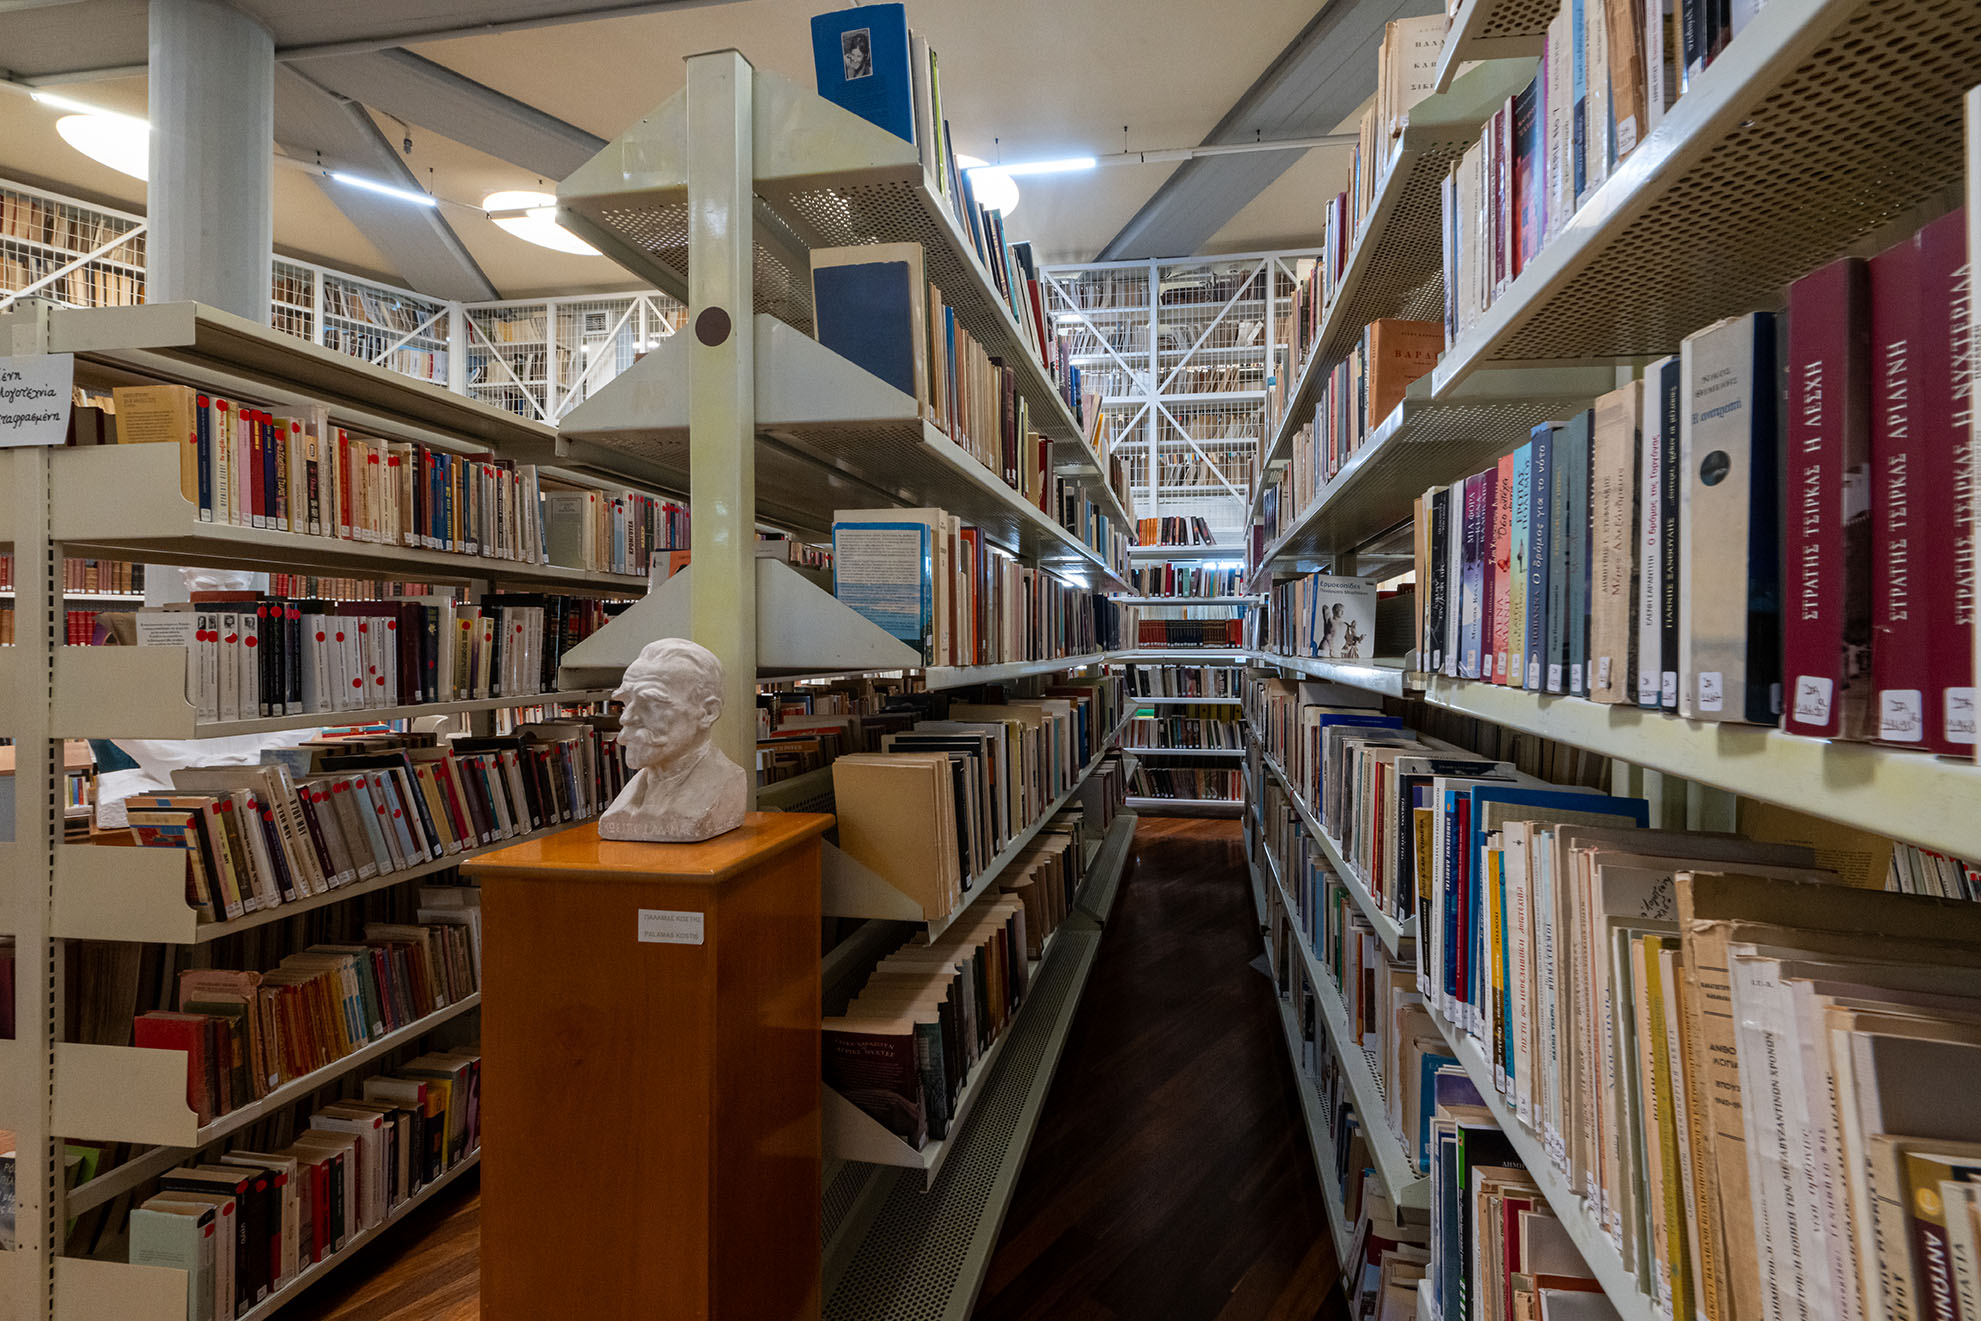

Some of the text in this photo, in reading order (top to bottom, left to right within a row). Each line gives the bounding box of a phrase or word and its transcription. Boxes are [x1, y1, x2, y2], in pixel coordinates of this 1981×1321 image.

[0, 368, 22, 382] ένη
[0, 409, 61, 429] ταφρασμένη
[1951, 412, 1972, 429] Η
[1536, 444, 1546, 473] νότο
[1648, 434, 1661, 479] Γοργόνας
[1537, 478, 1545, 493] το
[1650, 481, 1660, 497] της
[1802, 360, 1824, 621] ΣΤΡΑΤΗΣ ΤΣΙΡΚΑΣ Η ΛΕΣΧΗ
[1886, 339, 1909, 622] ΣΤΡΑΤΗΣ ΤΣΙΡΚΑΣ ΑΡΙΑΓΝΗ
[1953, 441, 1974, 531] ΤΣΙΡΚΑΣ
[1536, 498, 1546, 519] για
[1648, 499, 1659, 535] δρόμος
[1533, 522, 1545, 568] δρόμος
[1666, 517, 1676, 629] ΓΙΑΝΝΗΣ ΞΑΝΘΟΥΛΗΣ
[1954, 536, 1976, 626] ΣΤΡΑΤΗΣ
[644, 914, 675, 922] ΠΑΛΑΜΑΣ
[644, 930, 700, 940] PALAMAS KOSTIS
[1764, 1032, 1780, 1077] ΧΡΟΝΩΝ
[1770, 1080, 1793, 1181] ΜΕΤΑΒΥΖΑΝΤΙΝΩΝ
[1782, 1184, 1795, 1208] ΤΩΝ
